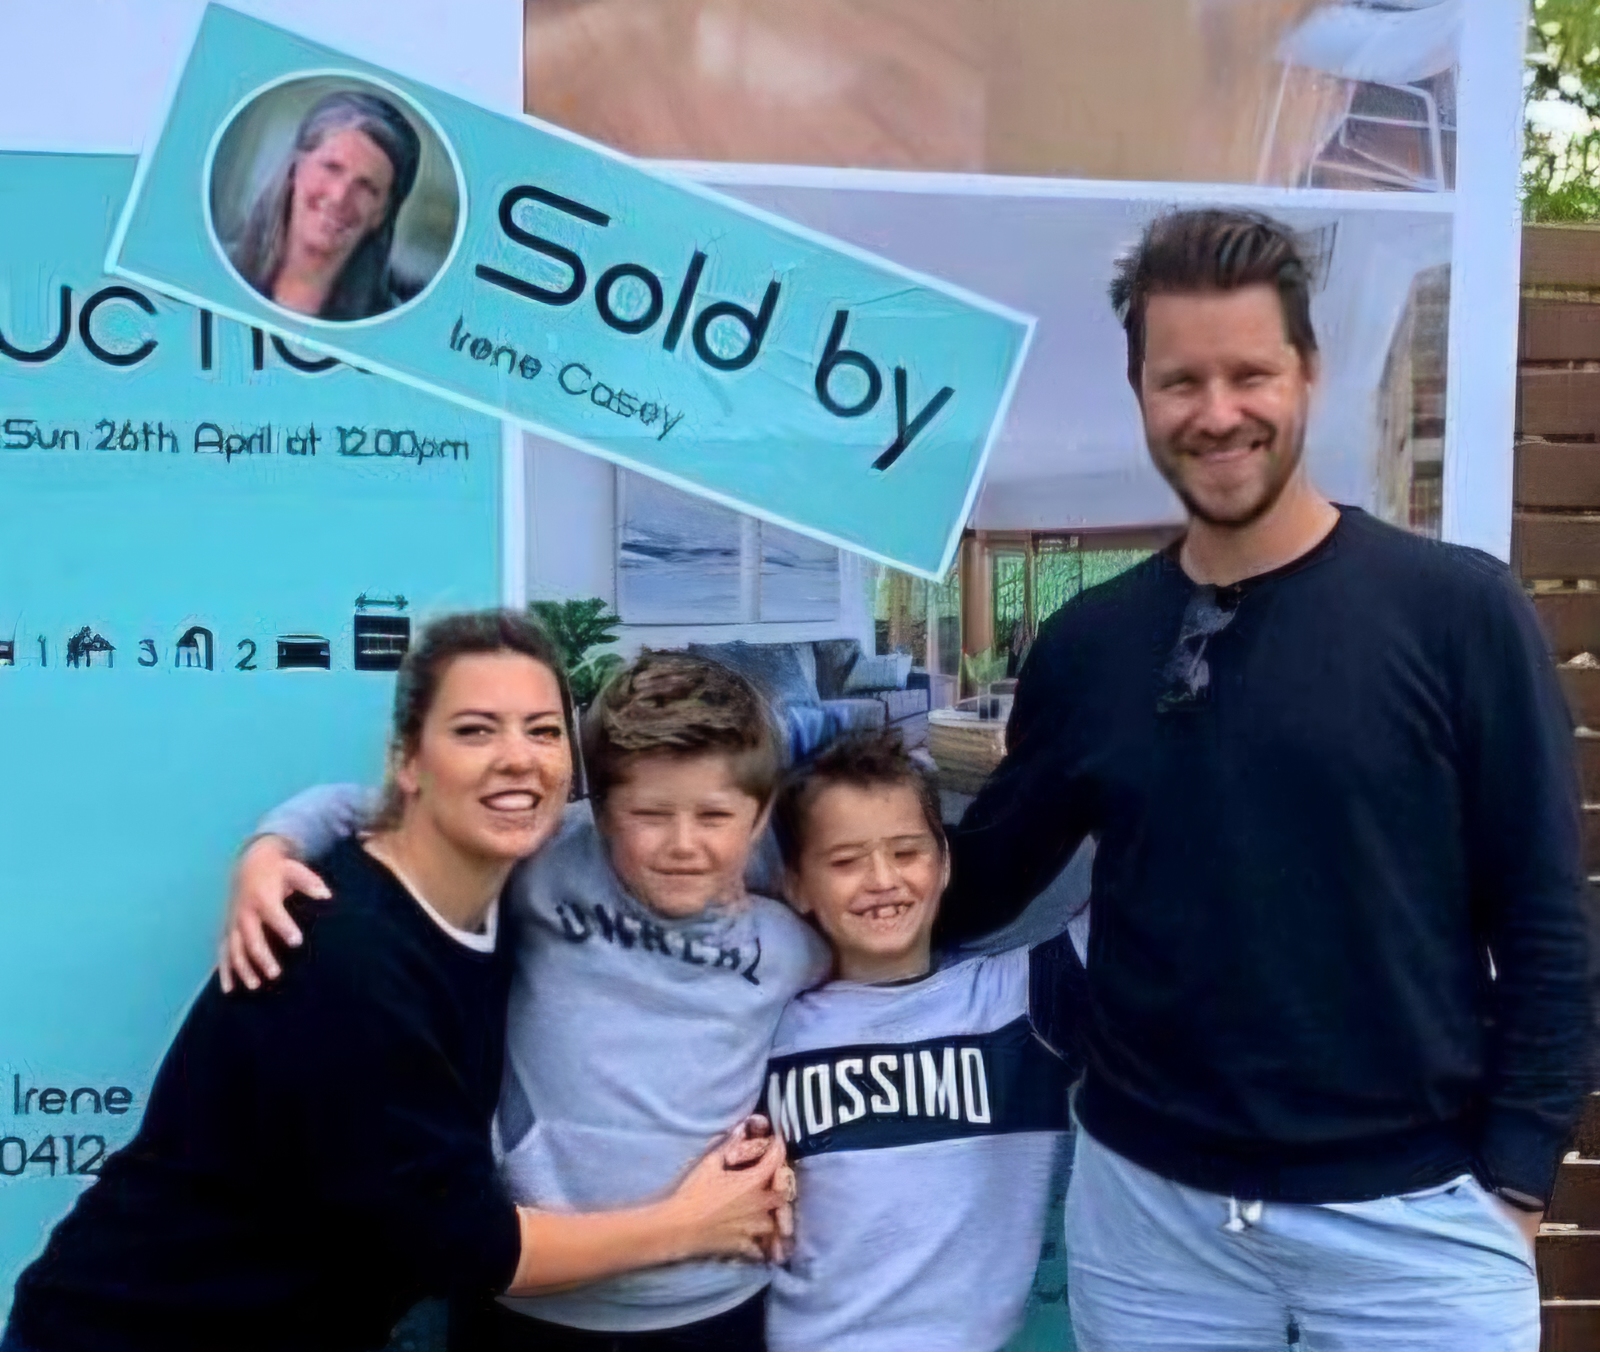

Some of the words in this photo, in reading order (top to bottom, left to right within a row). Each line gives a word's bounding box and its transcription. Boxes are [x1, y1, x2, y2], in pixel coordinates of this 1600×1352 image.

[475, 185, 782, 372] Sold
[814, 309, 956, 472] by
[557, 361, 685, 441] Casey
[2, 418, 80, 450] Sun
[95, 418, 180, 453] 26th
[194, 421, 272, 463] April
[285, 421, 322, 457] at
[138, 638, 159, 668] 3
[236, 638, 258, 671] 2
[13, 1072, 134, 1115] Irene
[767, 1046, 992, 1146] MOSSIMO
[0, 1133, 107, 1177] 0412
